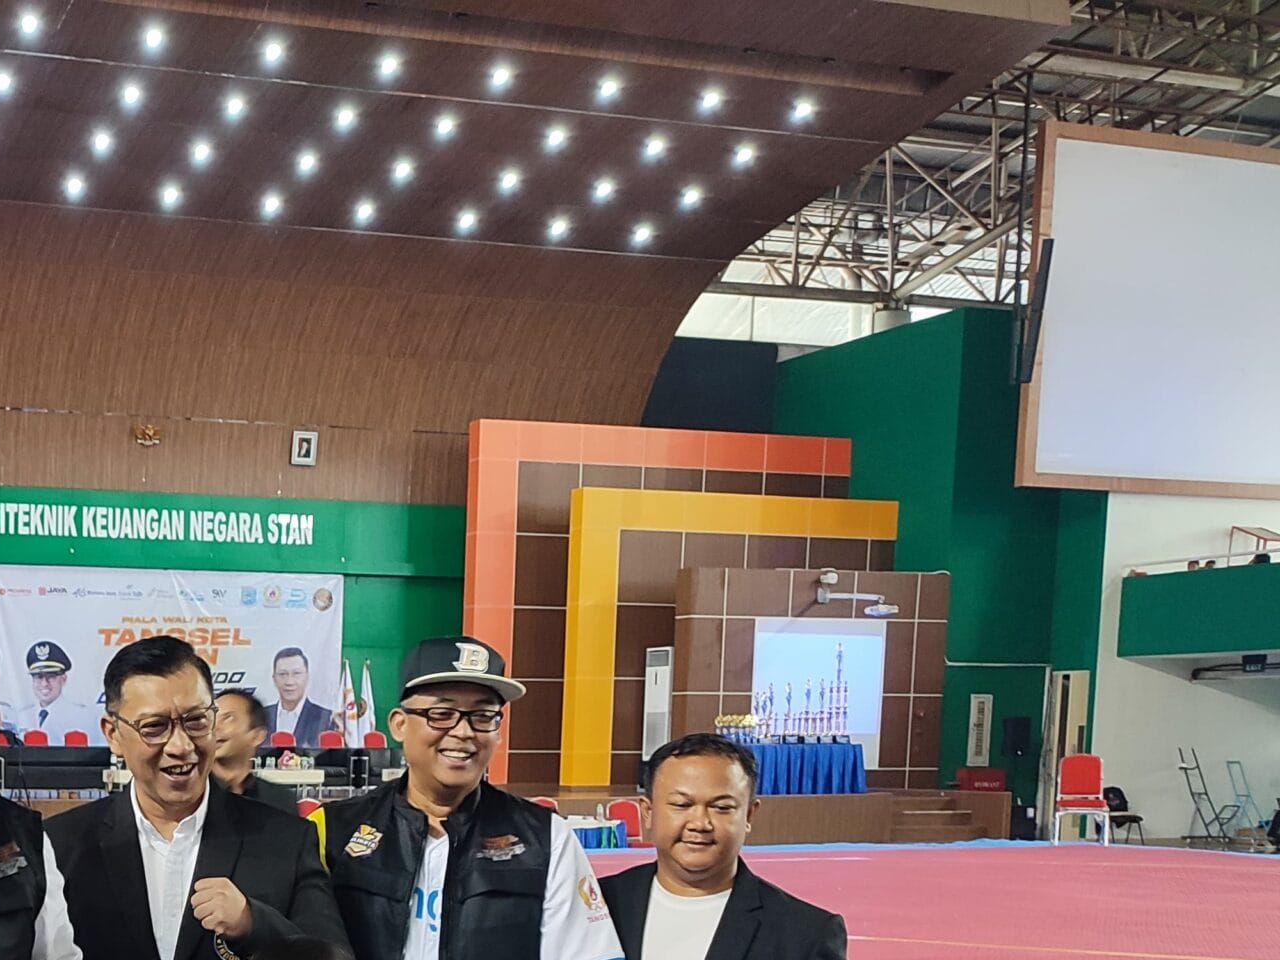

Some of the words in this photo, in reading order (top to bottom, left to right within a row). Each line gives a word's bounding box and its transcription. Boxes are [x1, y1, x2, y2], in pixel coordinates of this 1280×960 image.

[82, 505, 185, 541] KEUANGAN
[189, 510, 264, 544] NEGARA
[267, 514, 314, 545] STAN
[451, 642, 490, 673] B
